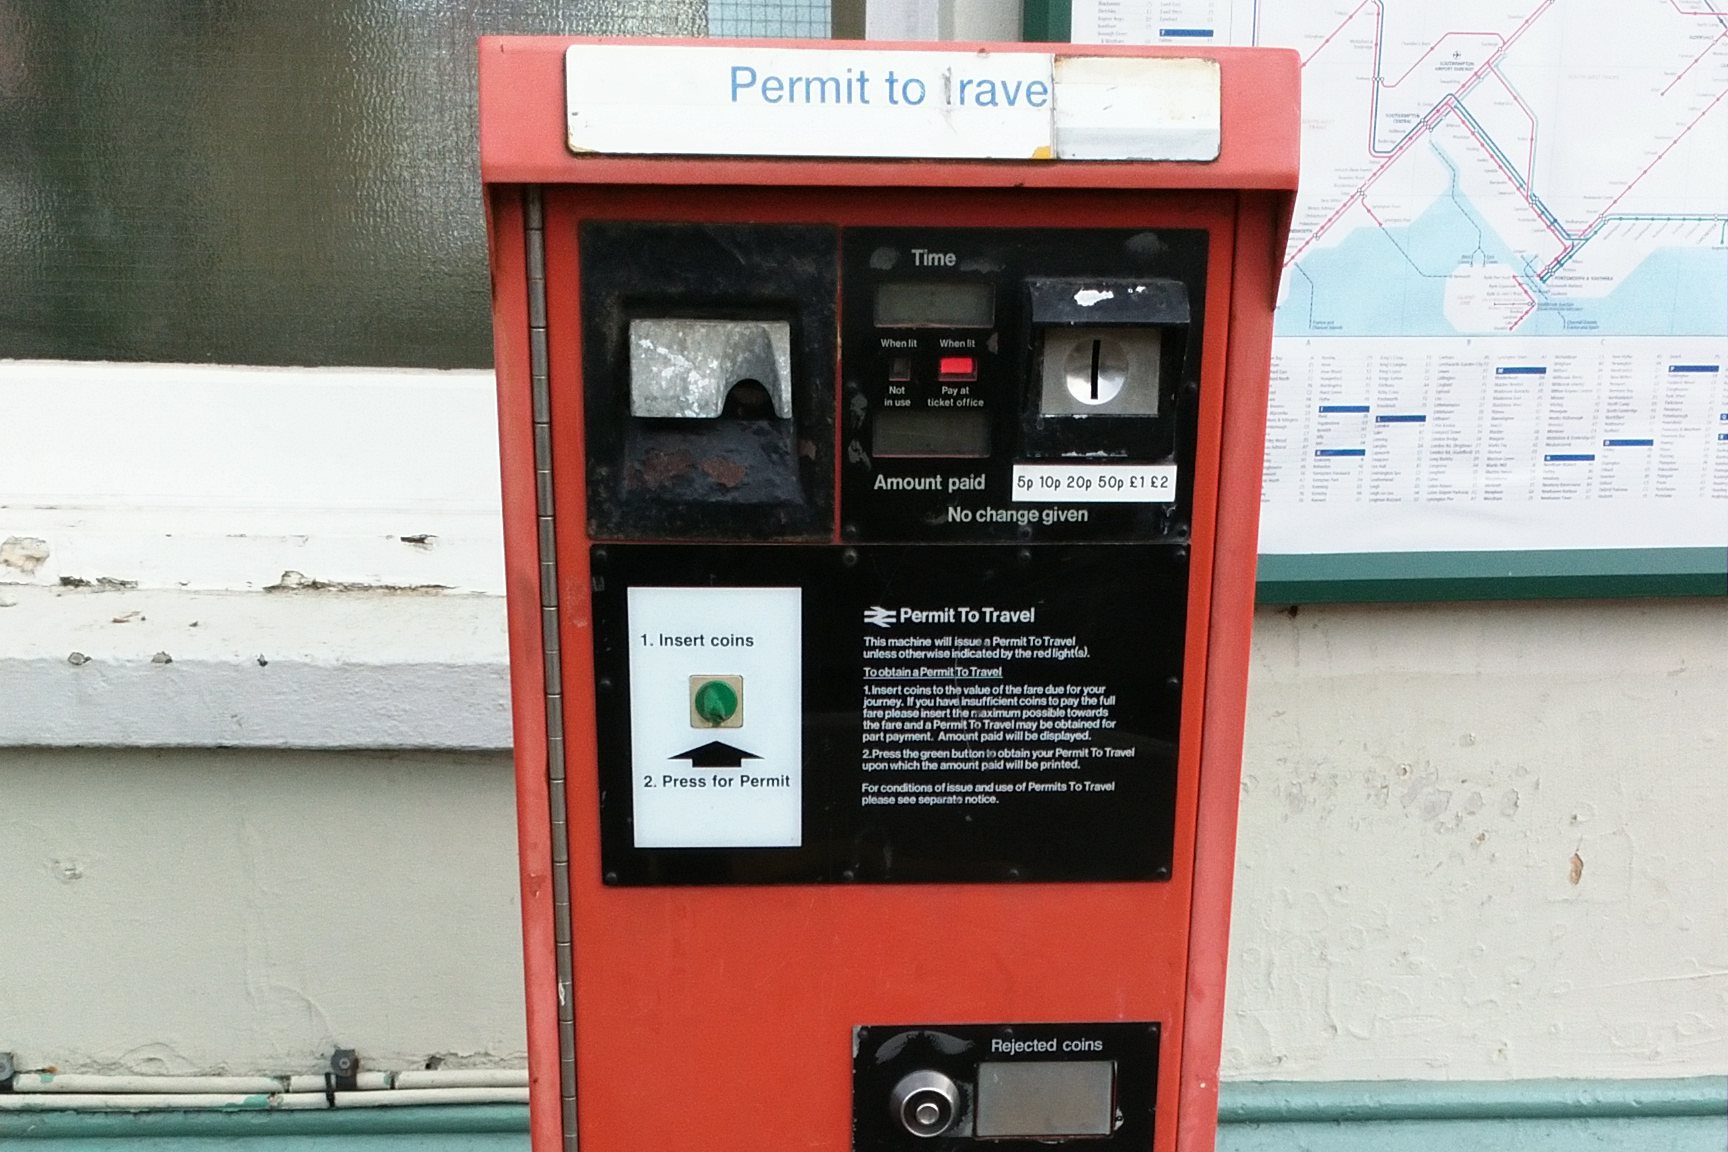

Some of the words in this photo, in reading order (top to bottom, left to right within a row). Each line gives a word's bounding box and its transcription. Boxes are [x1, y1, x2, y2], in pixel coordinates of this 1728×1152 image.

[731, 66, 870, 104] Permit
[885, 70, 926, 105] to
[911, 249, 957, 266] Time
[880, 339, 907, 348] When
[908, 339, 917, 348] lit
[940, 339, 966, 348] When
[967, 339, 976, 348] lit
[889, 386, 905, 395] Not
[941, 386, 958, 396] Pay
[960, 386, 969, 395] at
[884, 398, 893, 407] in
[895, 399, 911, 407] use
[927, 398, 954, 407] ticket
[956, 398, 984, 407] office
[874, 474, 942, 490] Amount
[948, 473, 985, 493] paid
[1017, 475, 1034, 491] 5p
[1039, 475, 1061, 491] 10p
[1066, 475, 1092, 491] 20p
[1098, 475, 1124, 491] 50p
[1130, 475, 1145, 488] £1
[1150, 475, 1169, 488] £2
[948, 507, 972, 522] No
[976, 506, 1039, 525] change
[1042, 505, 1088, 525] given
[900, 607, 955, 622] Permit
[958, 606, 980, 622] To
[982, 606, 1035, 622] Travel
[641, 633, 654, 647] 1.
[659, 633, 705, 647] Insert
[711, 633, 754, 647] coins
[864, 636, 886, 647] This
[888, 636, 931, 646] machine
[934, 636, 952, 646] will
[955, 636, 982, 646] issue
[984, 638, 990, 646] a
[992, 636, 1027, 646] Permit
[1028, 635, 1042, 646] To
[1043, 635, 1076, 646] Travel
[863, 648, 897, 659] unless
[898, 648, 950, 658] otherwise
[951, 648, 1000, 658] indicated
[1000, 648, 1013, 660] by
[1015, 648, 1032, 658] the
[1033, 647, 1051, 658] red
[1052, 645, 1090, 659] light(s).
[863, 666, 877, 678] To
[878, 666, 911, 678] obtain
[912, 668, 919, 677] a
[920, 666, 954, 677] Permit
[956, 666, 969, 677] To
[970, 666, 1002, 677] Travel
[903, 685, 932, 695] coins
[933, 685, 943, 695] to
[945, 684, 961, 695] the
[963, 684, 991, 695] value
[992, 684, 1004, 695] of
[1005, 684, 1022, 695] the
[1023, 684, 1043, 695] fare
[1045, 684, 1064, 695] due
[1066, 684, 1081, 694] for
[1083, 686, 1106, 696] your
[862, 697, 904, 709] journey.
[907, 697, 914, 706] If
[916, 698, 934, 708] you
[936, 696, 960, 706] have
[961, 696, 1018, 706] insufficient
[1019, 696, 1047, 706] coins
[1048, 696, 1059, 706] to
[1060, 698, 1079, 707] pay
[1081, 696, 1097, 705] the
[1099, 696, 1116, 705] full
[863, 709, 883, 719] fare
[885, 709, 919, 720] please
[921, 709, 950, 718] insert
[952, 708, 969, 718] the
[971, 708, 1021, 718] maximum
[1022, 708, 1065, 720] possible
[1067, 708, 1109, 717] towards
[863, 720, 880, 730] the
[881, 720, 902, 730] fare
[903, 720, 923, 729] and
[925, 721, 932, 729] a
[933, 719, 967, 729] Permit
[968, 719, 981, 729] To
[983, 719, 1015, 729] Travel
[1016, 721, 1038, 731] may
[1040, 719, 1053, 729] be
[1055, 719, 1100, 728] obtained
[1102, 719, 1116, 728] for
[862, 731, 884, 744] part
[886, 731, 934, 743] payment.
[938, 731, 978, 741] Amount
[980, 731, 1004, 743] paid
[1006, 731, 1023, 741] will
[1025, 730, 1038, 741] be
[1040, 730, 1091, 742] displayed.
[902, 749, 919, 759] the
[920, 751, 950, 761] green
[951, 749, 985, 759] button
[987, 749, 996, 758] to
[997, 749, 1030, 758] obtain
[1032, 750, 1054, 760] your
[1055, 748, 1089, 758] Permit
[1090, 748, 1103, 758] To
[1104, 748, 1135, 758] Travel
[862, 763, 888, 773] upon
[890, 761, 920, 770] which
[922, 761, 938, 770] the
[940, 760, 979, 770] amount
[981, 760, 1004, 772] paid
[1006, 760, 1023, 770] will
[1025, 760, 1039, 770] be
[1040, 760, 1080, 772] printed.
[644, 775, 657, 788] 2.
[663, 775, 707, 788] Press
[713, 774, 734, 788] for
[740, 774, 790, 788] Permit
[862, 783, 879, 793] For
[880, 783, 933, 792] conditions
[935, 783, 946, 792] of
[947, 782, 973, 792] issue
[975, 782, 994, 792] and
[995, 784, 1013, 792] use
[1015, 782, 1026, 792] of
[1028, 782, 1067, 792] Permits
[1069, 782, 1082, 791] To
[1084, 782, 1115, 791] Travel
[862, 795, 896, 807] please
[897, 797, 916, 805] see
[918, 795, 963, 807] separate
[965, 795, 999, 804] notice.
[991, 1038, 1057, 1055] Rejected
[1062, 1037, 1103, 1051] coins
